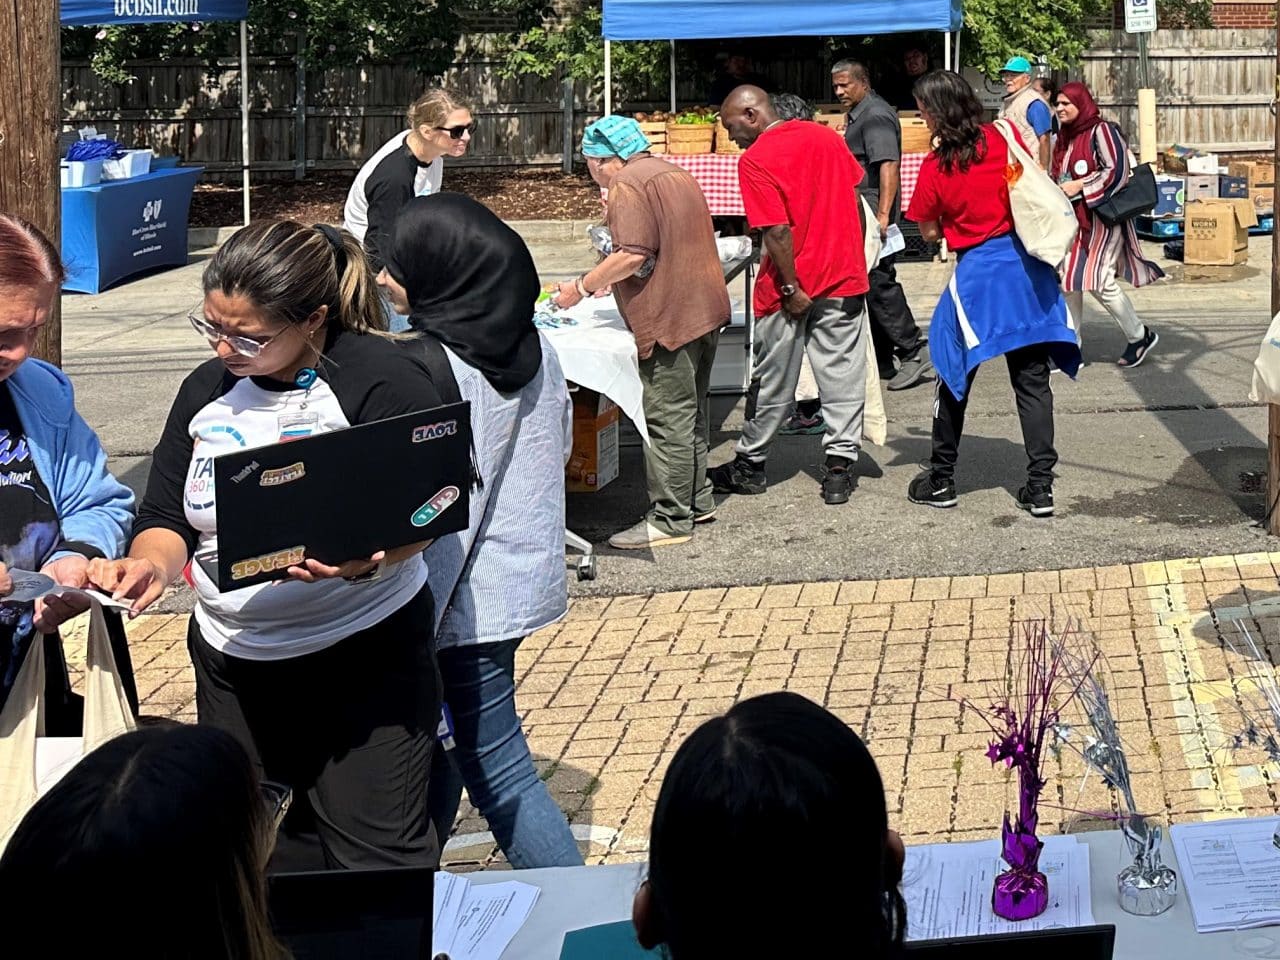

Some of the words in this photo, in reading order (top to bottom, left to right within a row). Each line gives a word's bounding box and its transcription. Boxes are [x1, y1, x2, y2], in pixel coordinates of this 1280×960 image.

[413, 420, 457, 442] LOVE
[193, 457, 213, 479] TA
[231, 545, 306, 580] PEACE
